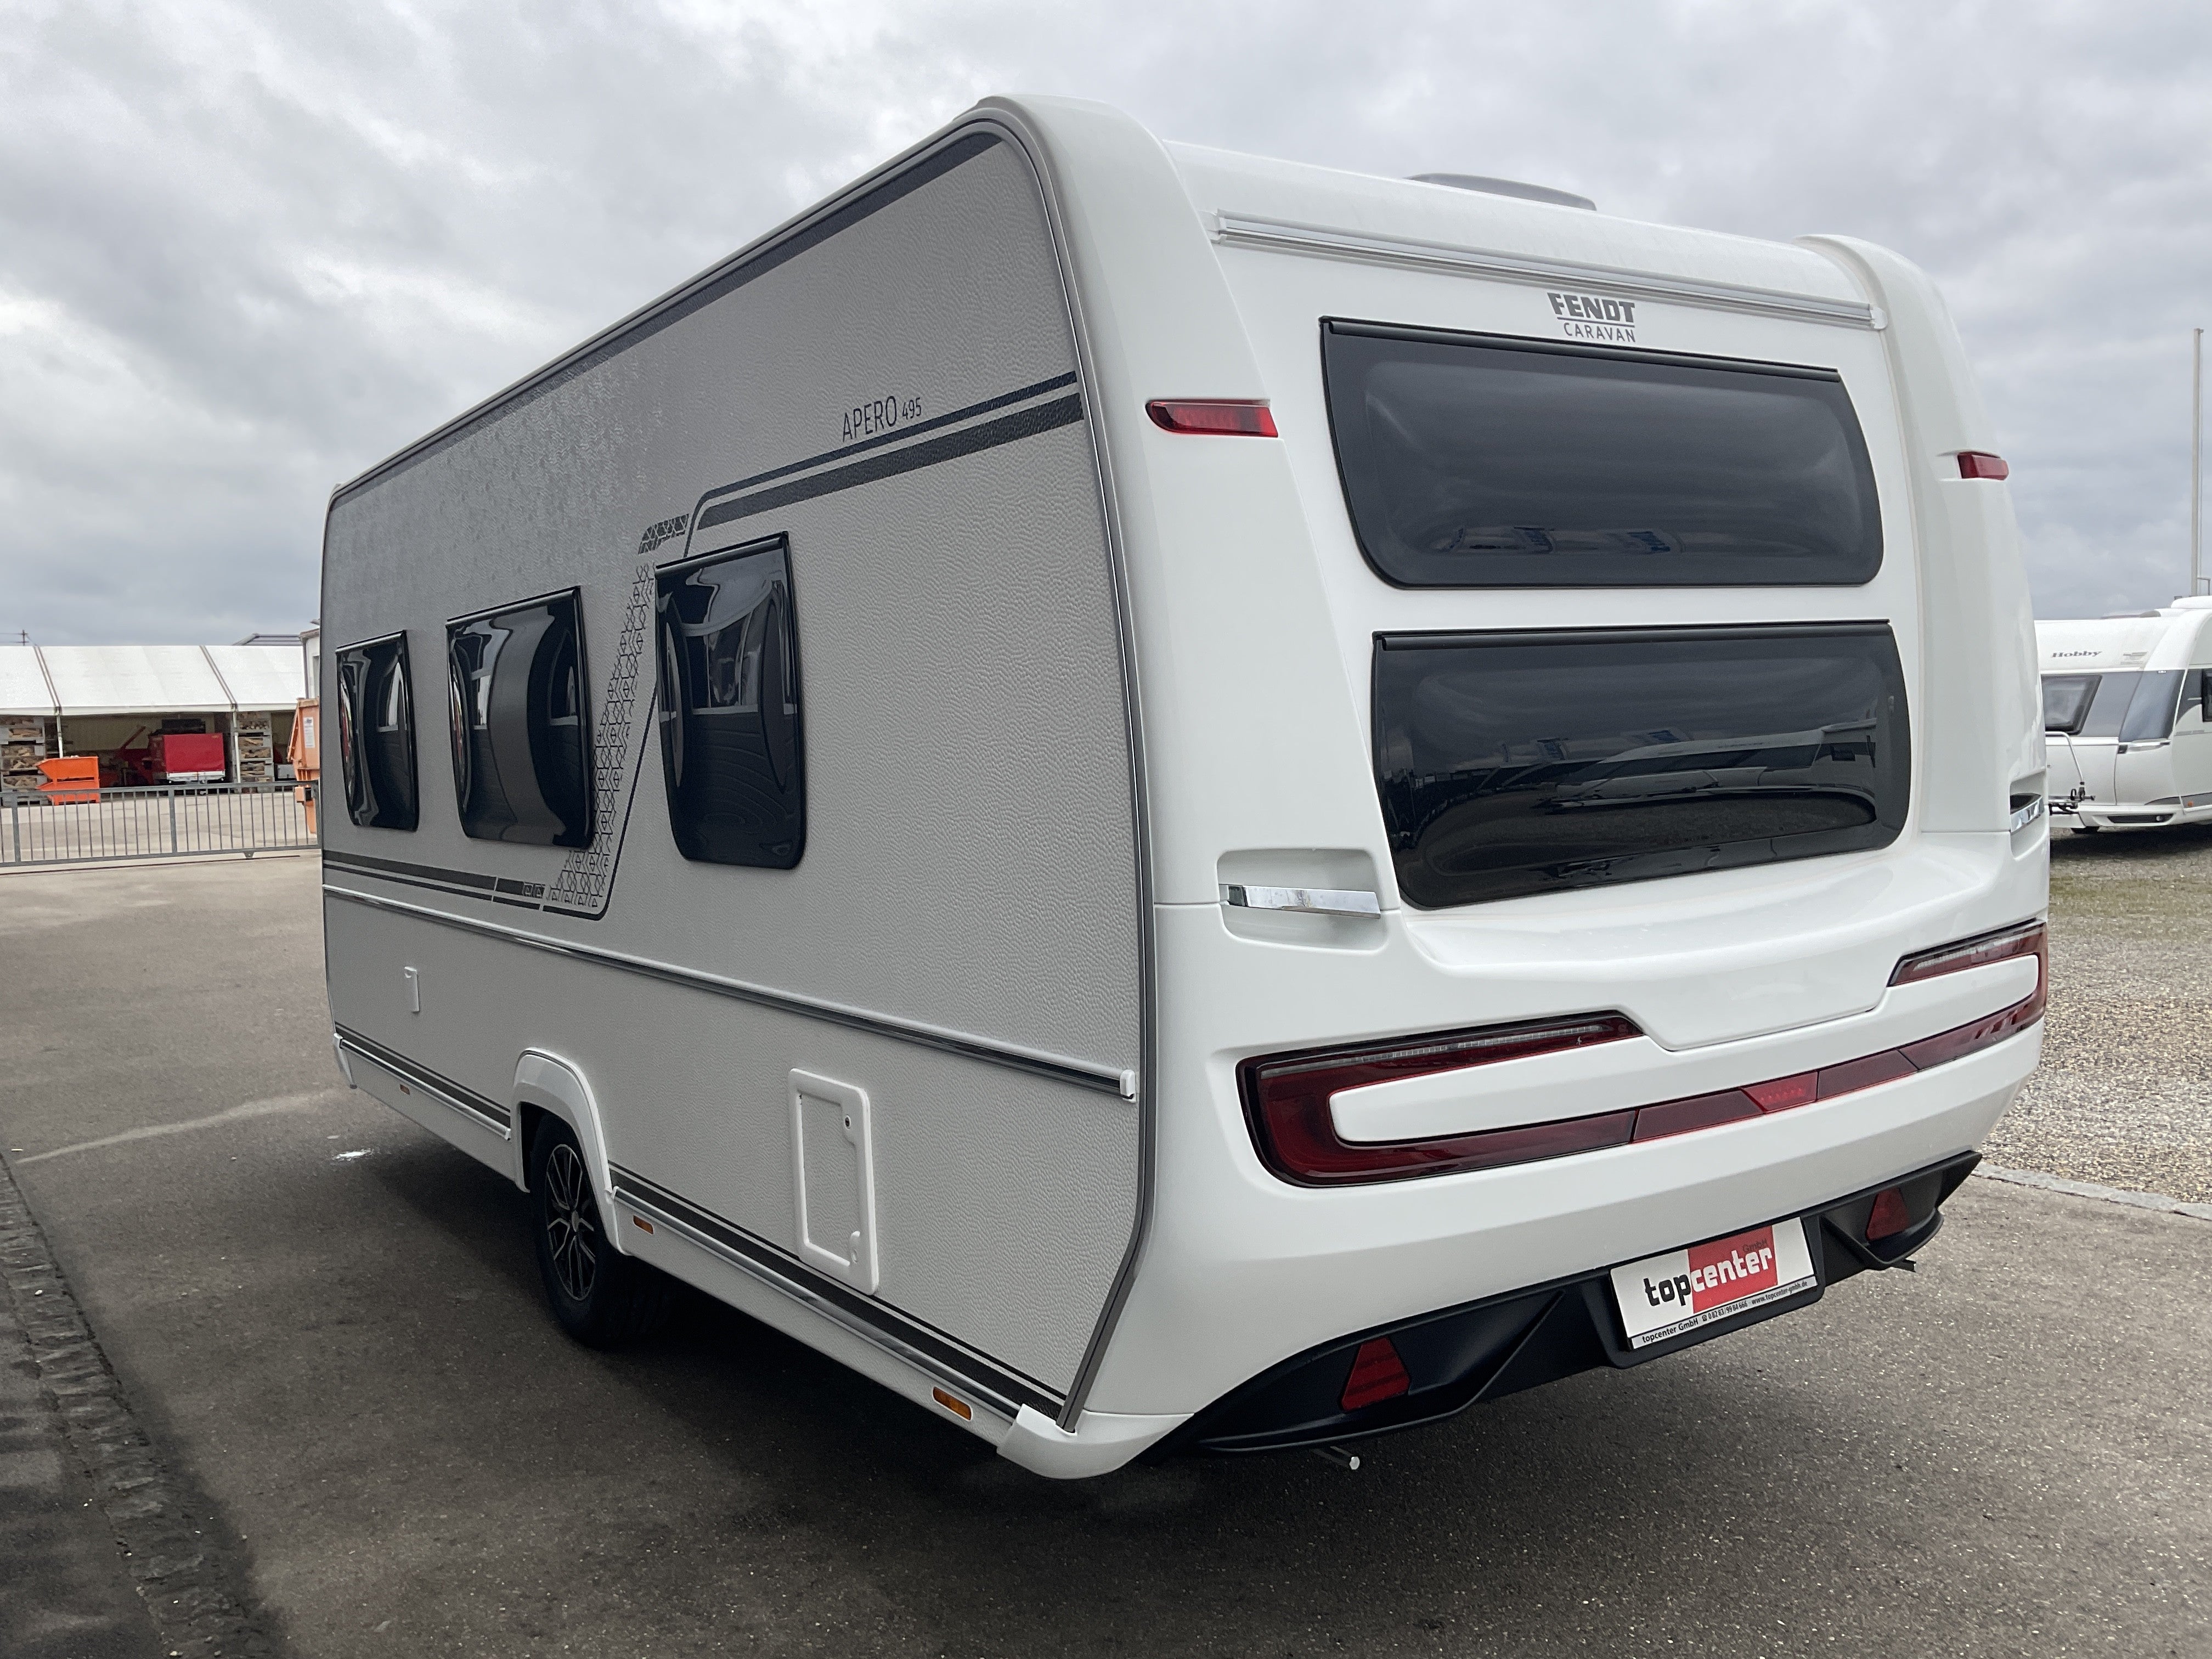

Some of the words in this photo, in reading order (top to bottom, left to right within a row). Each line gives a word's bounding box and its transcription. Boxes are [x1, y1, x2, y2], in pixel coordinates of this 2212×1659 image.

[1547, 292, 1635, 323] FENDT
[1564, 323, 1636, 343] CARAVAN
[842, 396, 897, 443] APERO
[902, 397, 922, 420] 495
[1643, 1246, 1773, 1307] topcenter
[1642, 1325, 1677, 1343] topcenter
[1678, 1317, 1699, 1330] GmbH
